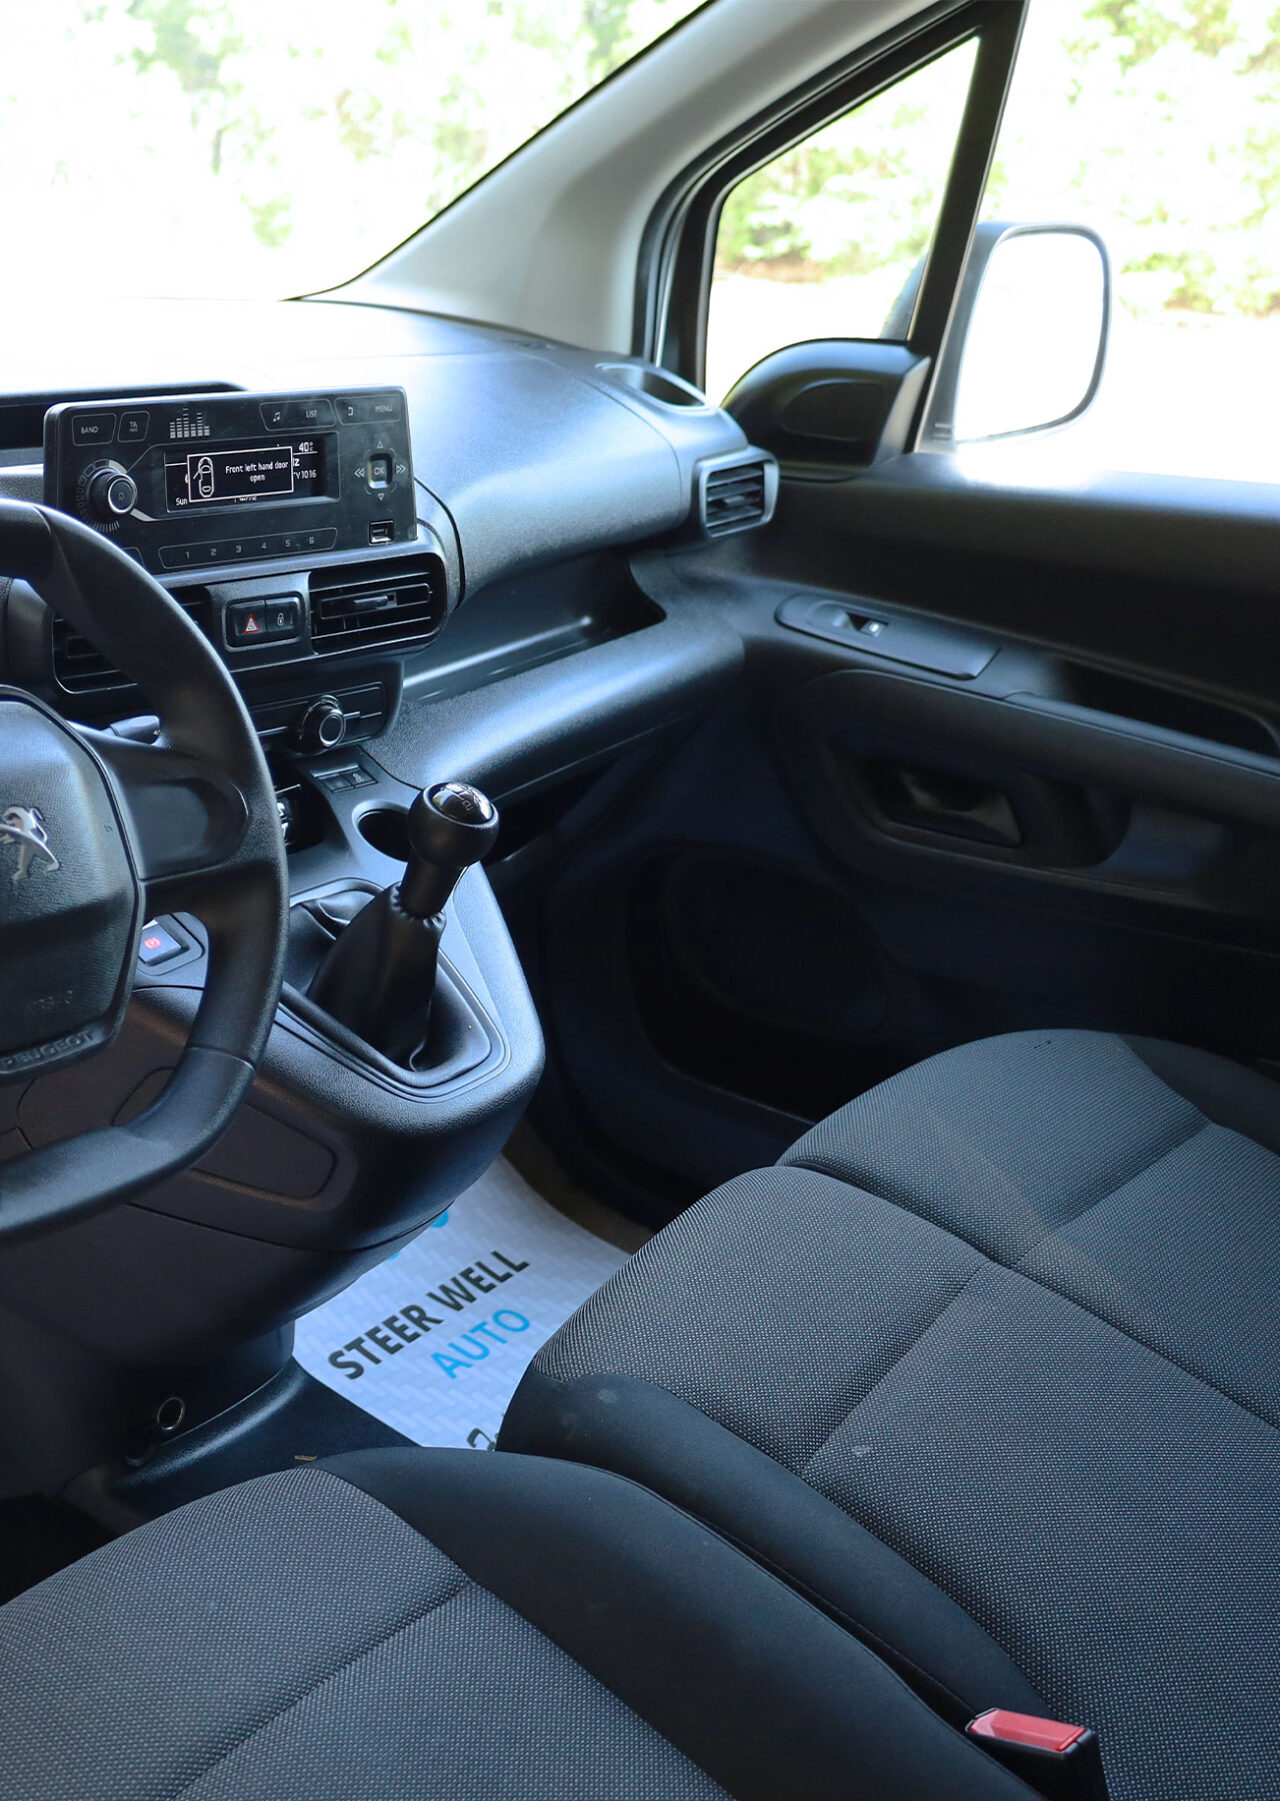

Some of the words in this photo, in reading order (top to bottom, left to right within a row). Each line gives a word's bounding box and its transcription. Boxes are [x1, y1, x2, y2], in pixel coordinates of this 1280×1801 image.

[306, 409, 318, 418] LIST
[374, 405, 393, 413] MENU
[81, 426, 98, 434] BAND
[225, 464, 244, 474] Front
[245, 464, 256, 472] left
[258, 462, 273, 471] hand
[274, 461, 289, 469] door
[249, 474, 265, 484] open
[185, 551, 190, 559] 1
[210, 548, 216, 556] 2
[235, 545, 242, 553] 3
[261, 542, 267, 550] 4
[285, 539, 291, 547] 5
[309, 536, 315, 544] 6
[0, 1030, 93, 1067] PEUGEOT
[327, 1304, 444, 1380] STEER
[425, 1250, 531, 1312] WELL
[429, 1308, 531, 1379] AUTO
